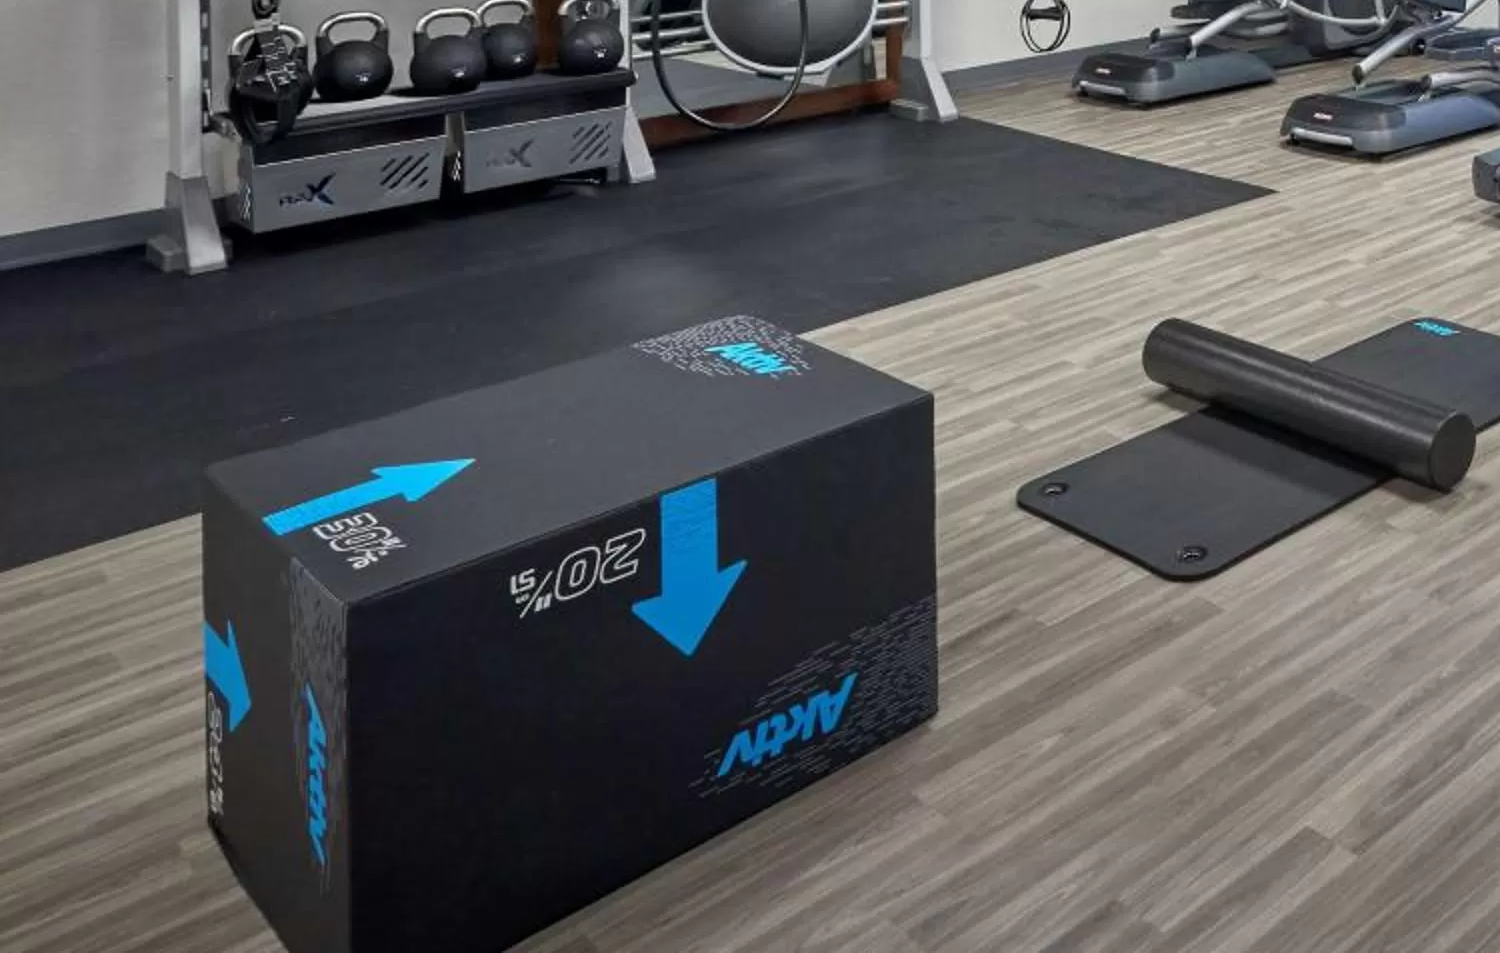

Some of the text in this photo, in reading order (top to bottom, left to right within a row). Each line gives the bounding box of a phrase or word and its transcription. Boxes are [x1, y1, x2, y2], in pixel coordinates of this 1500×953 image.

[704, 342, 797, 374] Aktiv
[305, 682, 329, 866] Aktiv
[717, 671, 860, 777] Aktiv
